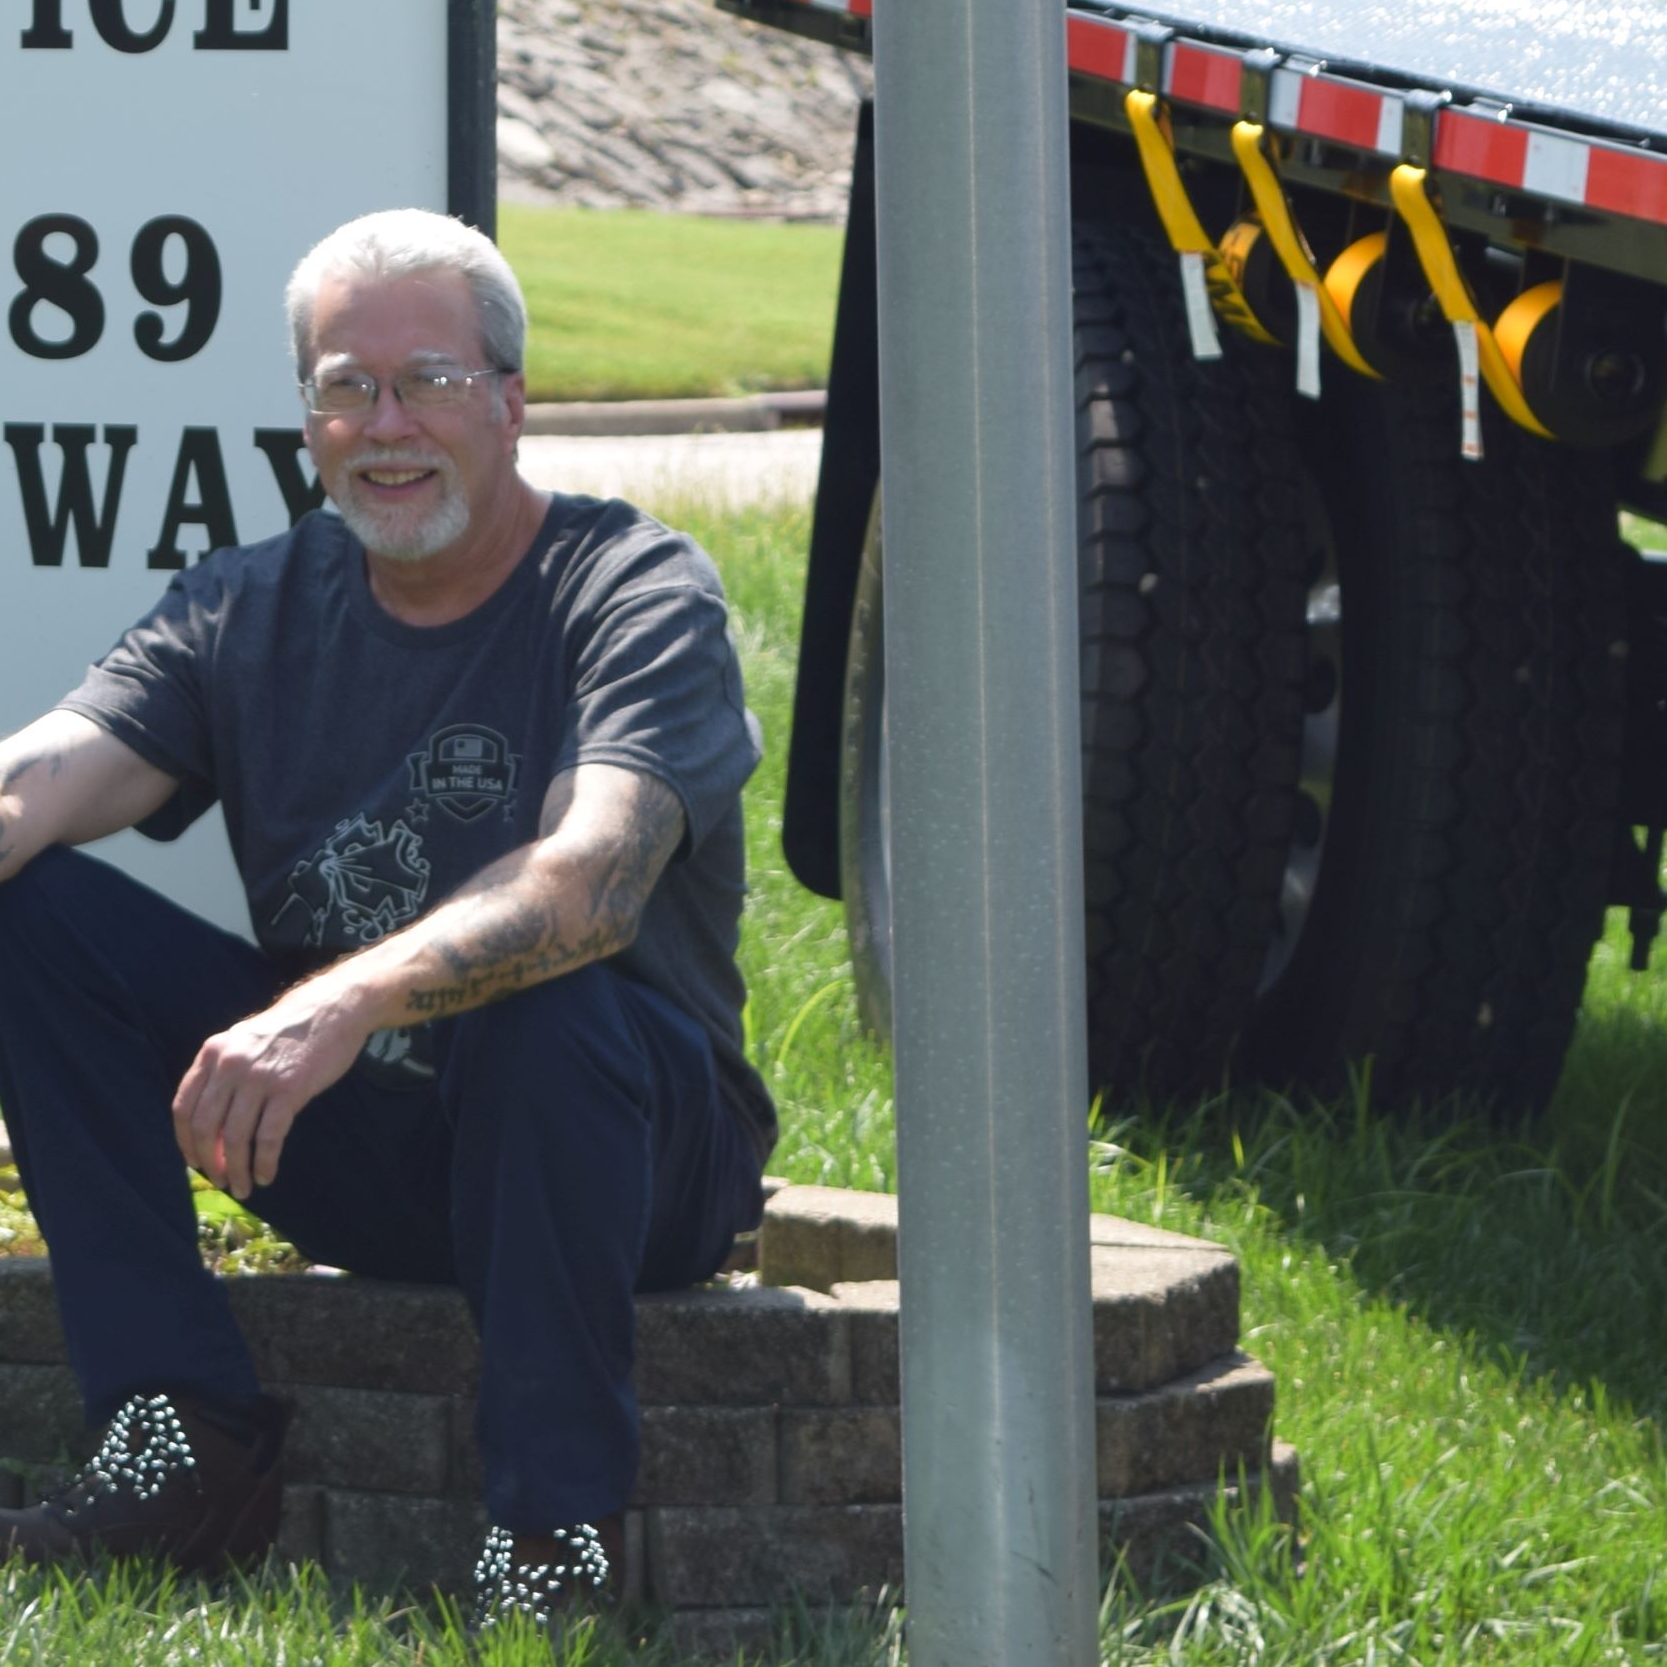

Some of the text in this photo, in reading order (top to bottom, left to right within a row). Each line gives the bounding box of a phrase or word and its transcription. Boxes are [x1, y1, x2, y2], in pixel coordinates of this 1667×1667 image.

[432, 776, 504, 790] IN THE USA
